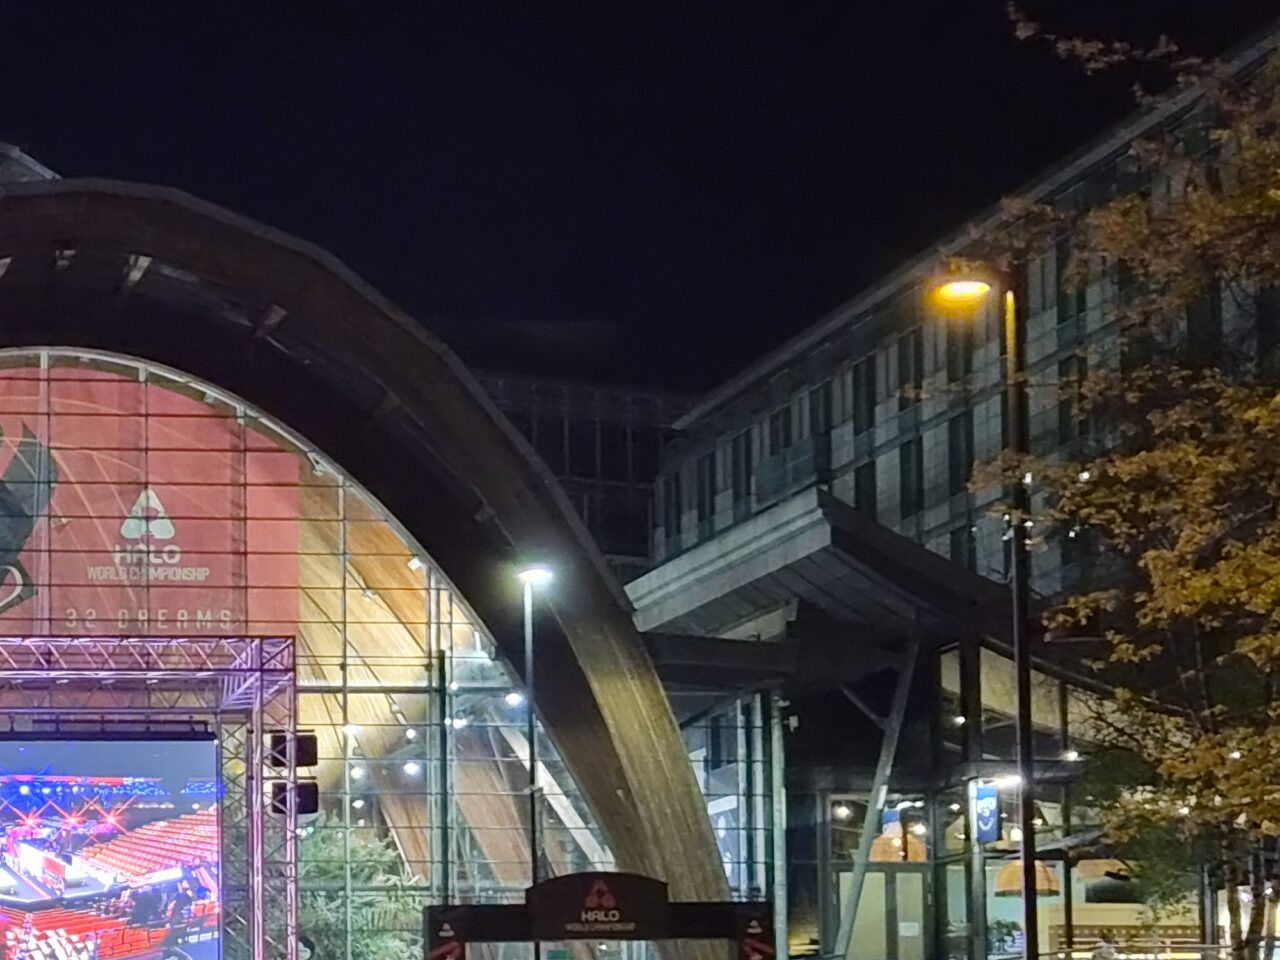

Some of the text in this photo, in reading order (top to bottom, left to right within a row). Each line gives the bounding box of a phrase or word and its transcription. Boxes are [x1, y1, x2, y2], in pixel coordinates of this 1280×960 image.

[114, 544, 181, 564] HALO
[86, 566, 127, 581] WORLD
[66, 608, 232, 630] 32 DREAMS
[581, 910, 620, 922] HALO
